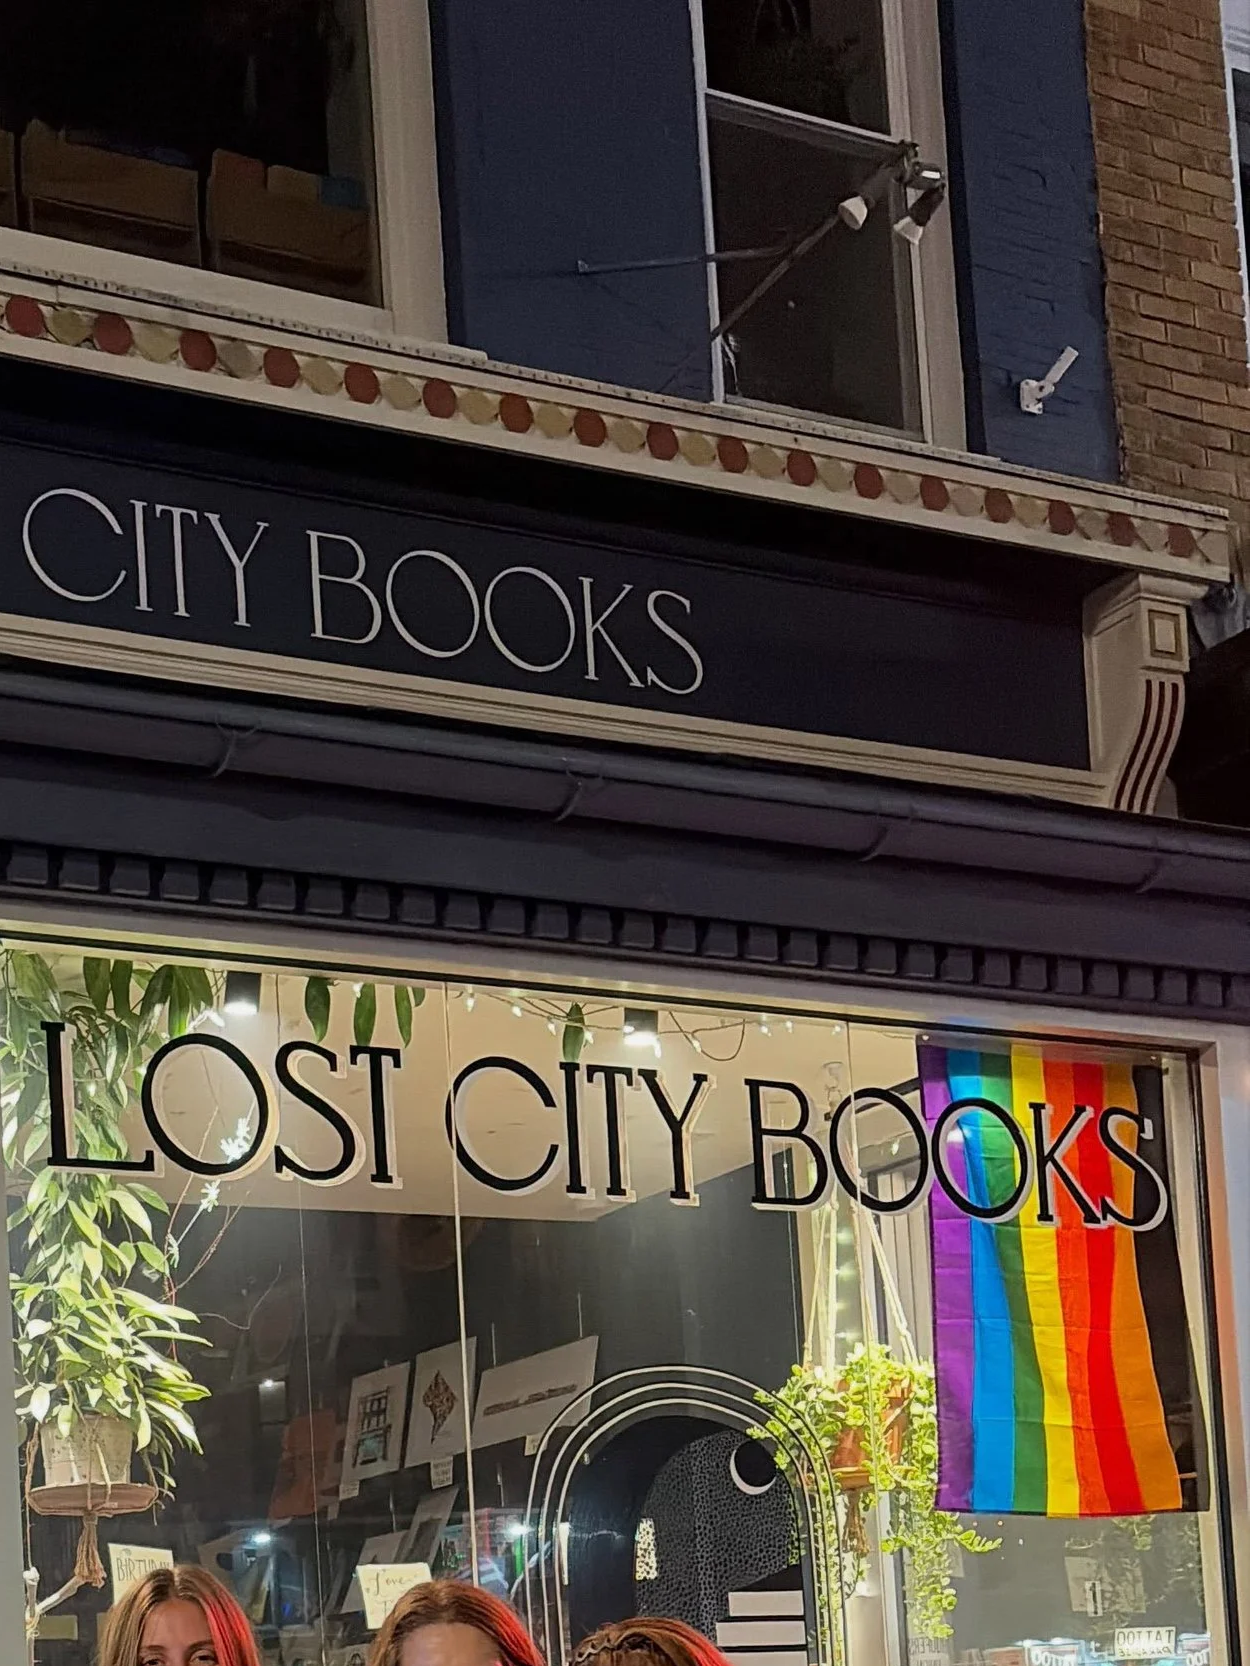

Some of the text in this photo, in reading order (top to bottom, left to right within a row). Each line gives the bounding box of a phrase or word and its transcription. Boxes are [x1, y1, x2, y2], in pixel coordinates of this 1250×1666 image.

[22, 487, 269, 628] CITY
[305, 529, 704, 695] BOOKS
[39, 1020, 1170, 1232] LOST CITY BOOKS
